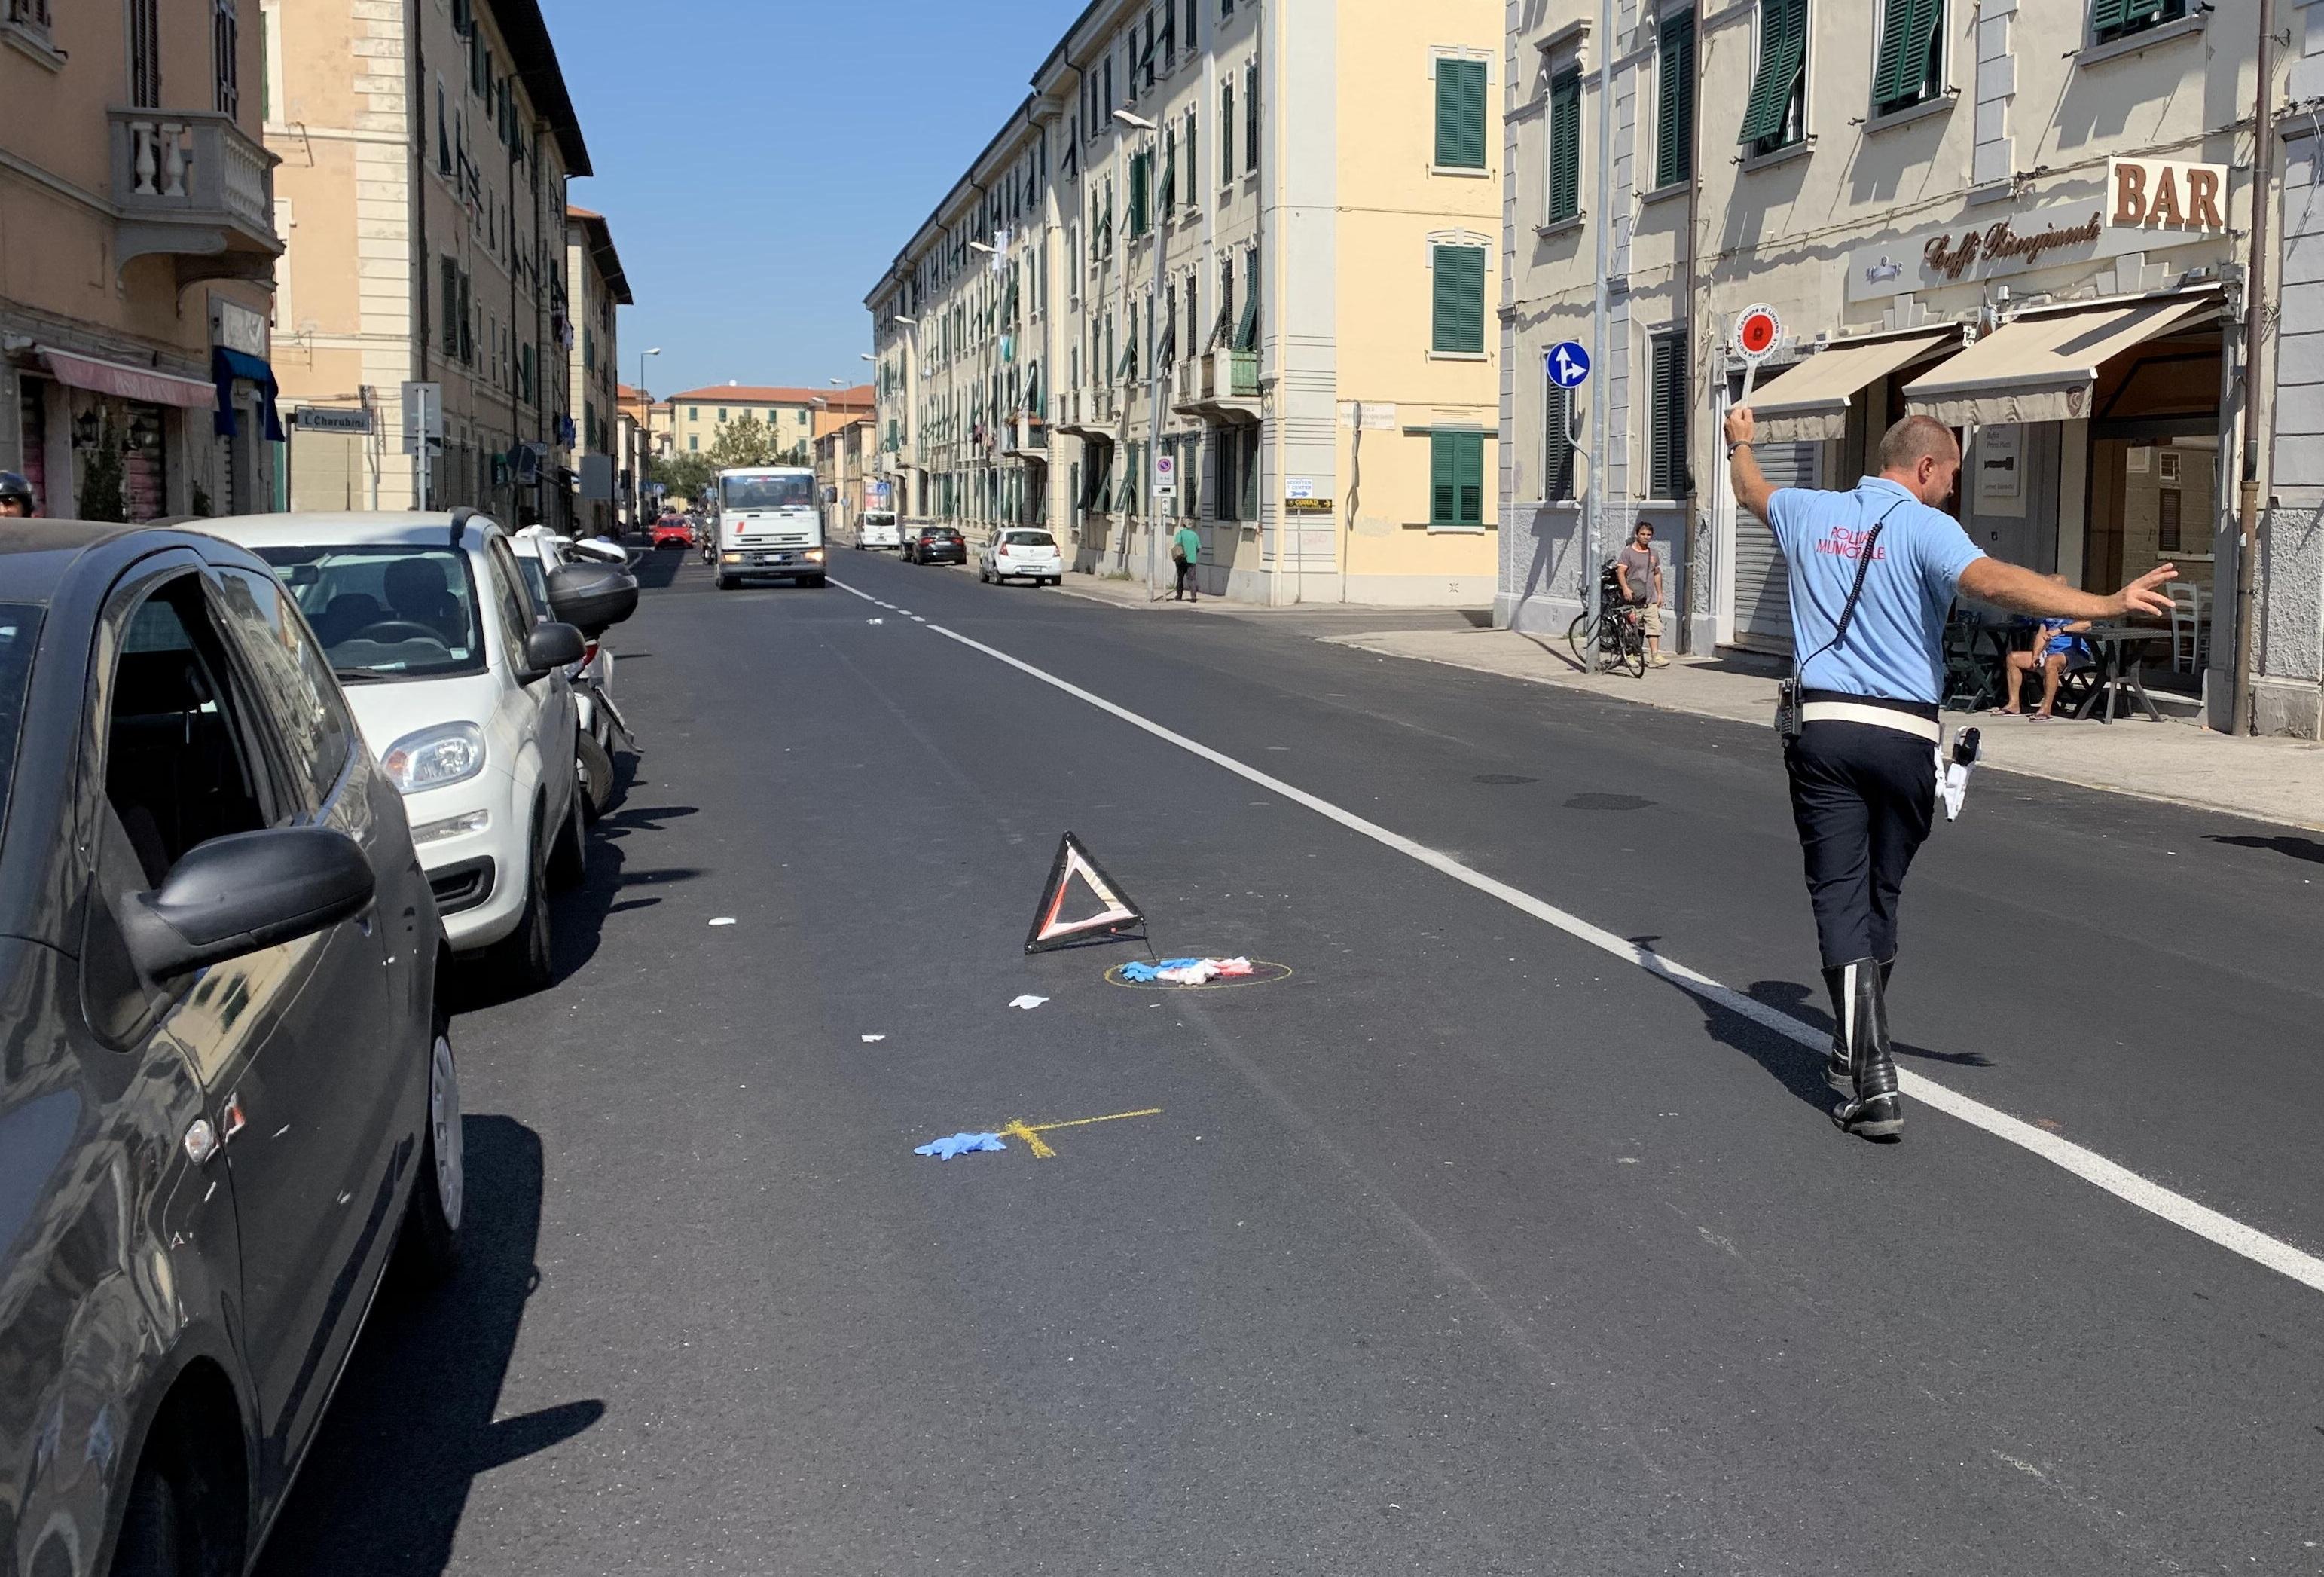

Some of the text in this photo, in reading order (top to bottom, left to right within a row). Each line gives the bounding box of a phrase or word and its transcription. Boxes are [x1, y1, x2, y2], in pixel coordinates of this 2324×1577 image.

[2112, 163, 2223, 231] BAR
[1738, 308, 1759, 330] Comune
[1768, 310, 1779, 334] Livorno
[1737, 335, 1777, 358] POLIZIA MUNICIPALE
[1830, 526, 1871, 546] POLIIA
[1816, 538, 1886, 560] MUNICPLE
